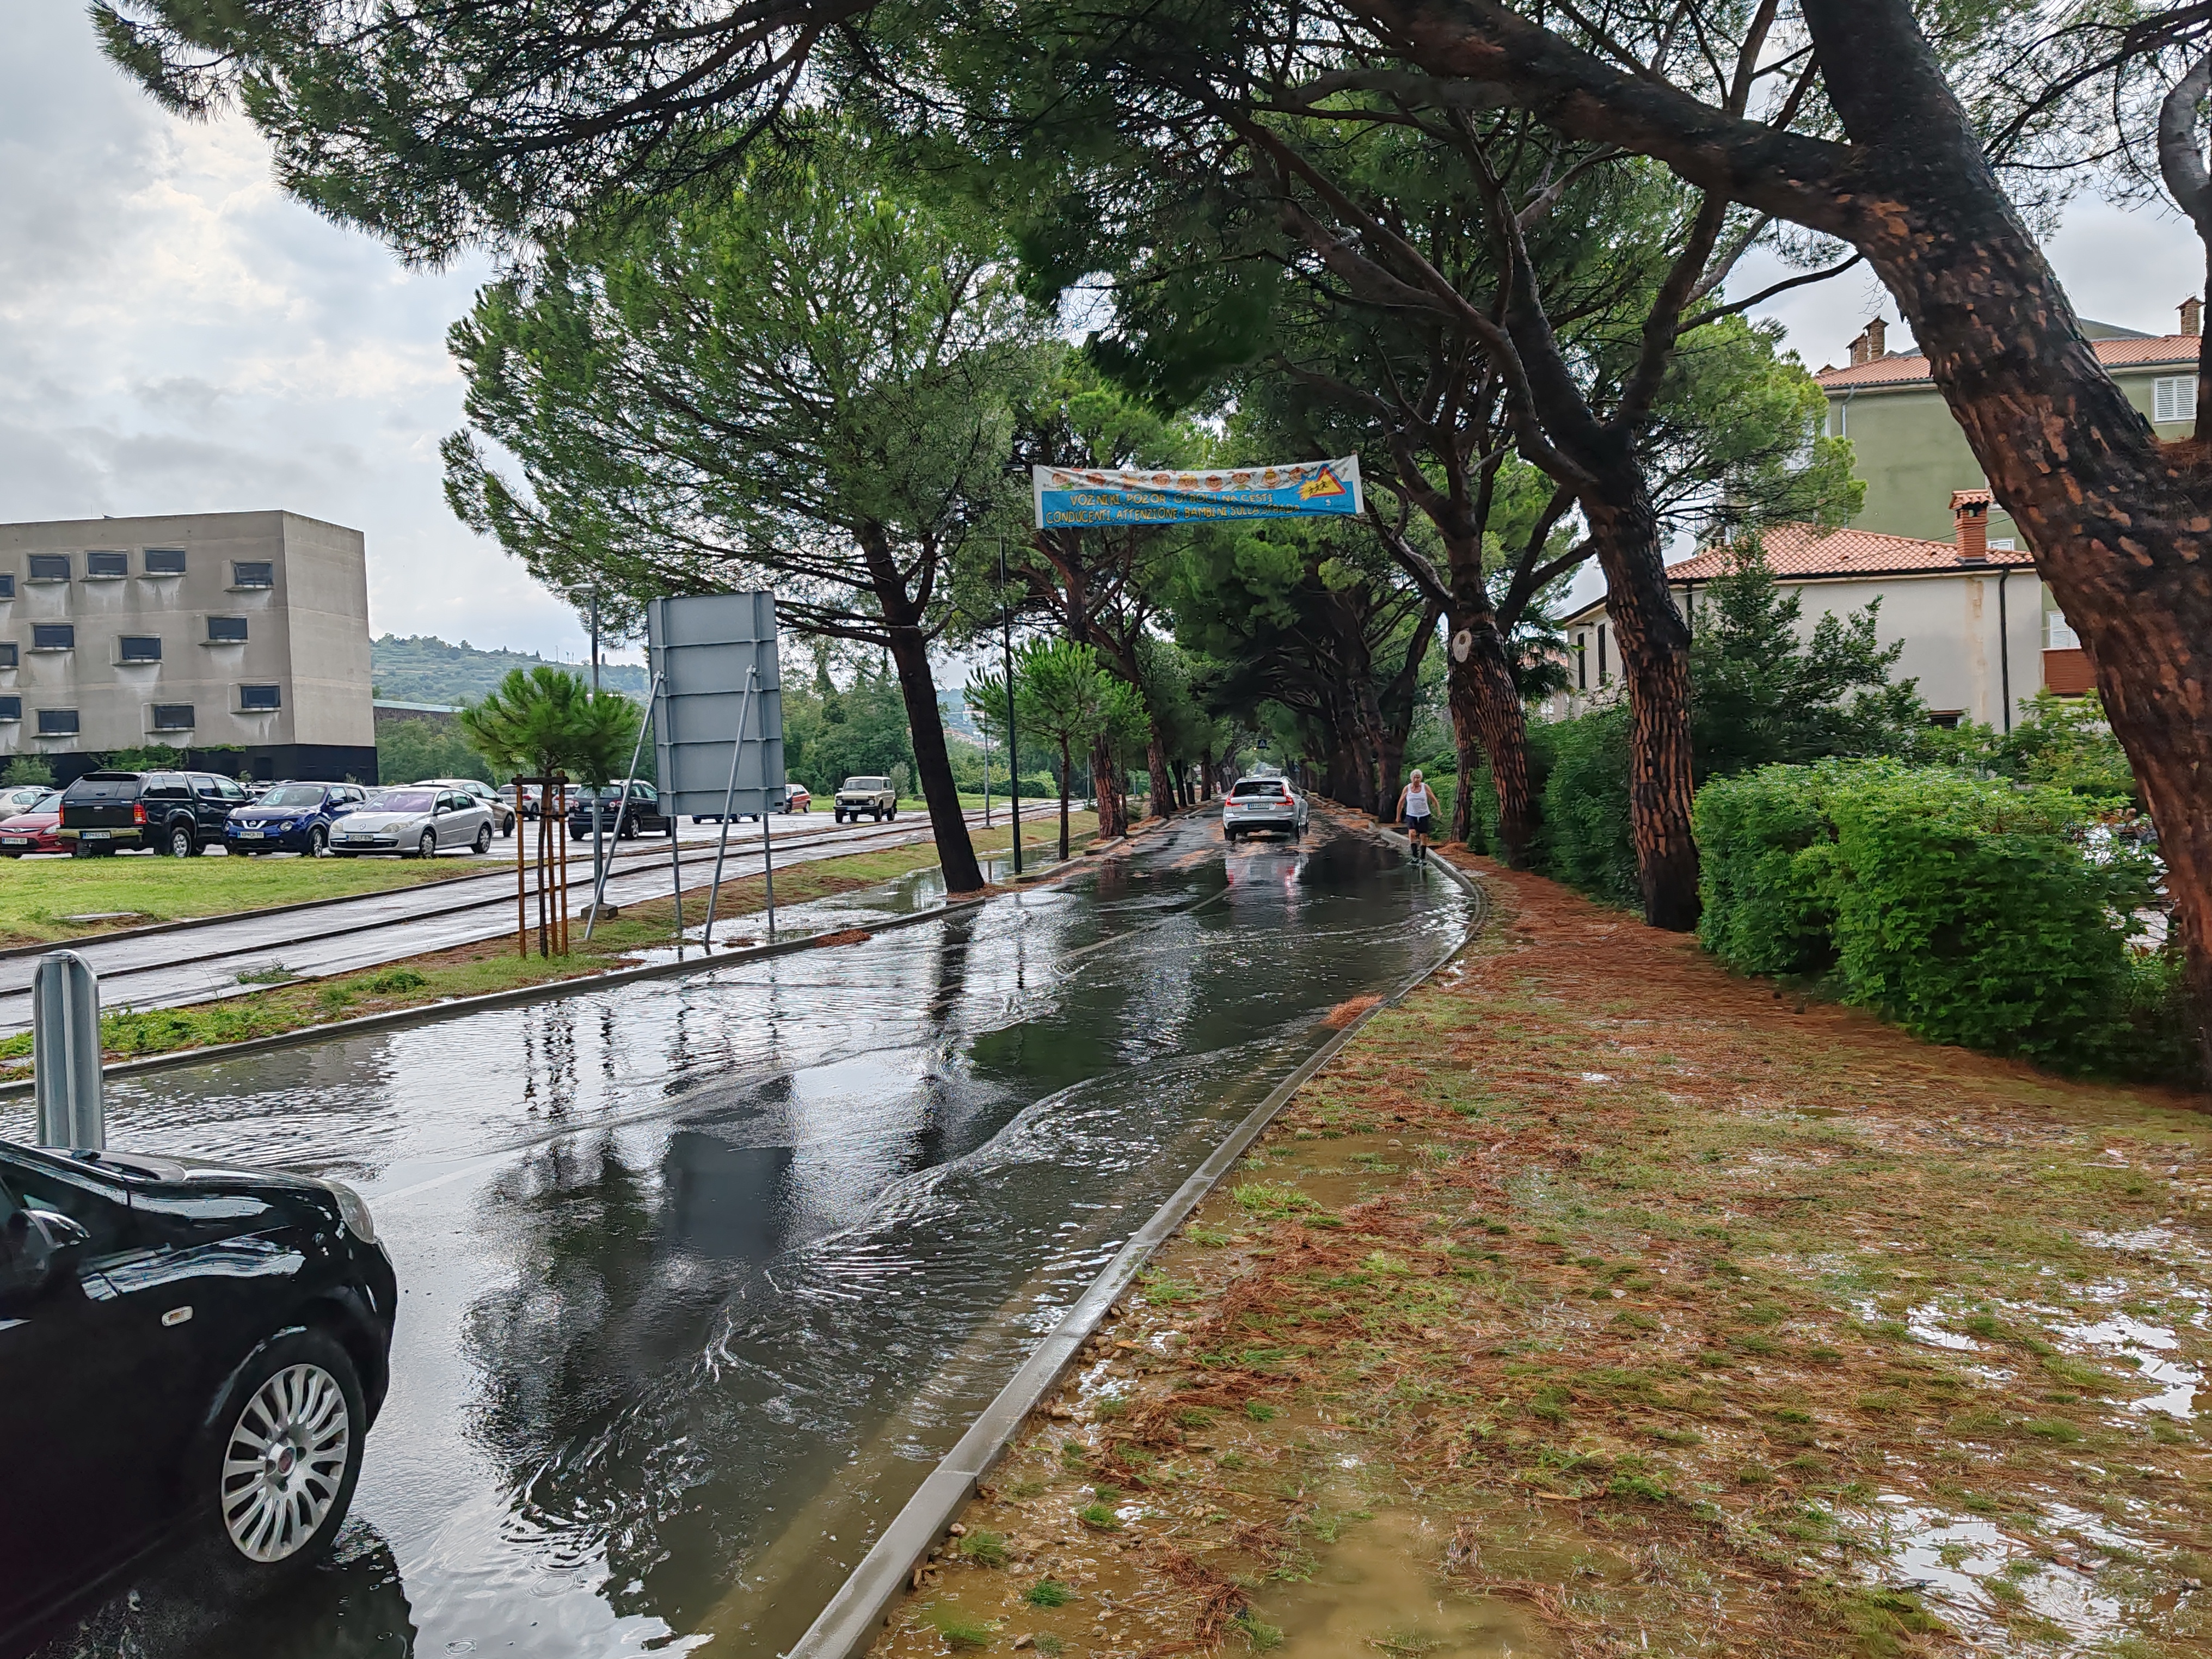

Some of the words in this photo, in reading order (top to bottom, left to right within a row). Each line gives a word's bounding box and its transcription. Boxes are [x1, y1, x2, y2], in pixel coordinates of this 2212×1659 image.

[1127, 493, 1166, 505] POZOR
[1174, 493, 1218, 503] OTROCI
[1222, 494, 1238, 502] NA
[1241, 493, 1273, 502] CESTI
[1116, 507, 1178, 522] ATTENZIONE
[1184, 506, 1228, 519] BAMBINI
[1231, 504, 1259, 515] SULLA
[1260, 503, 1301, 514] STRADA
